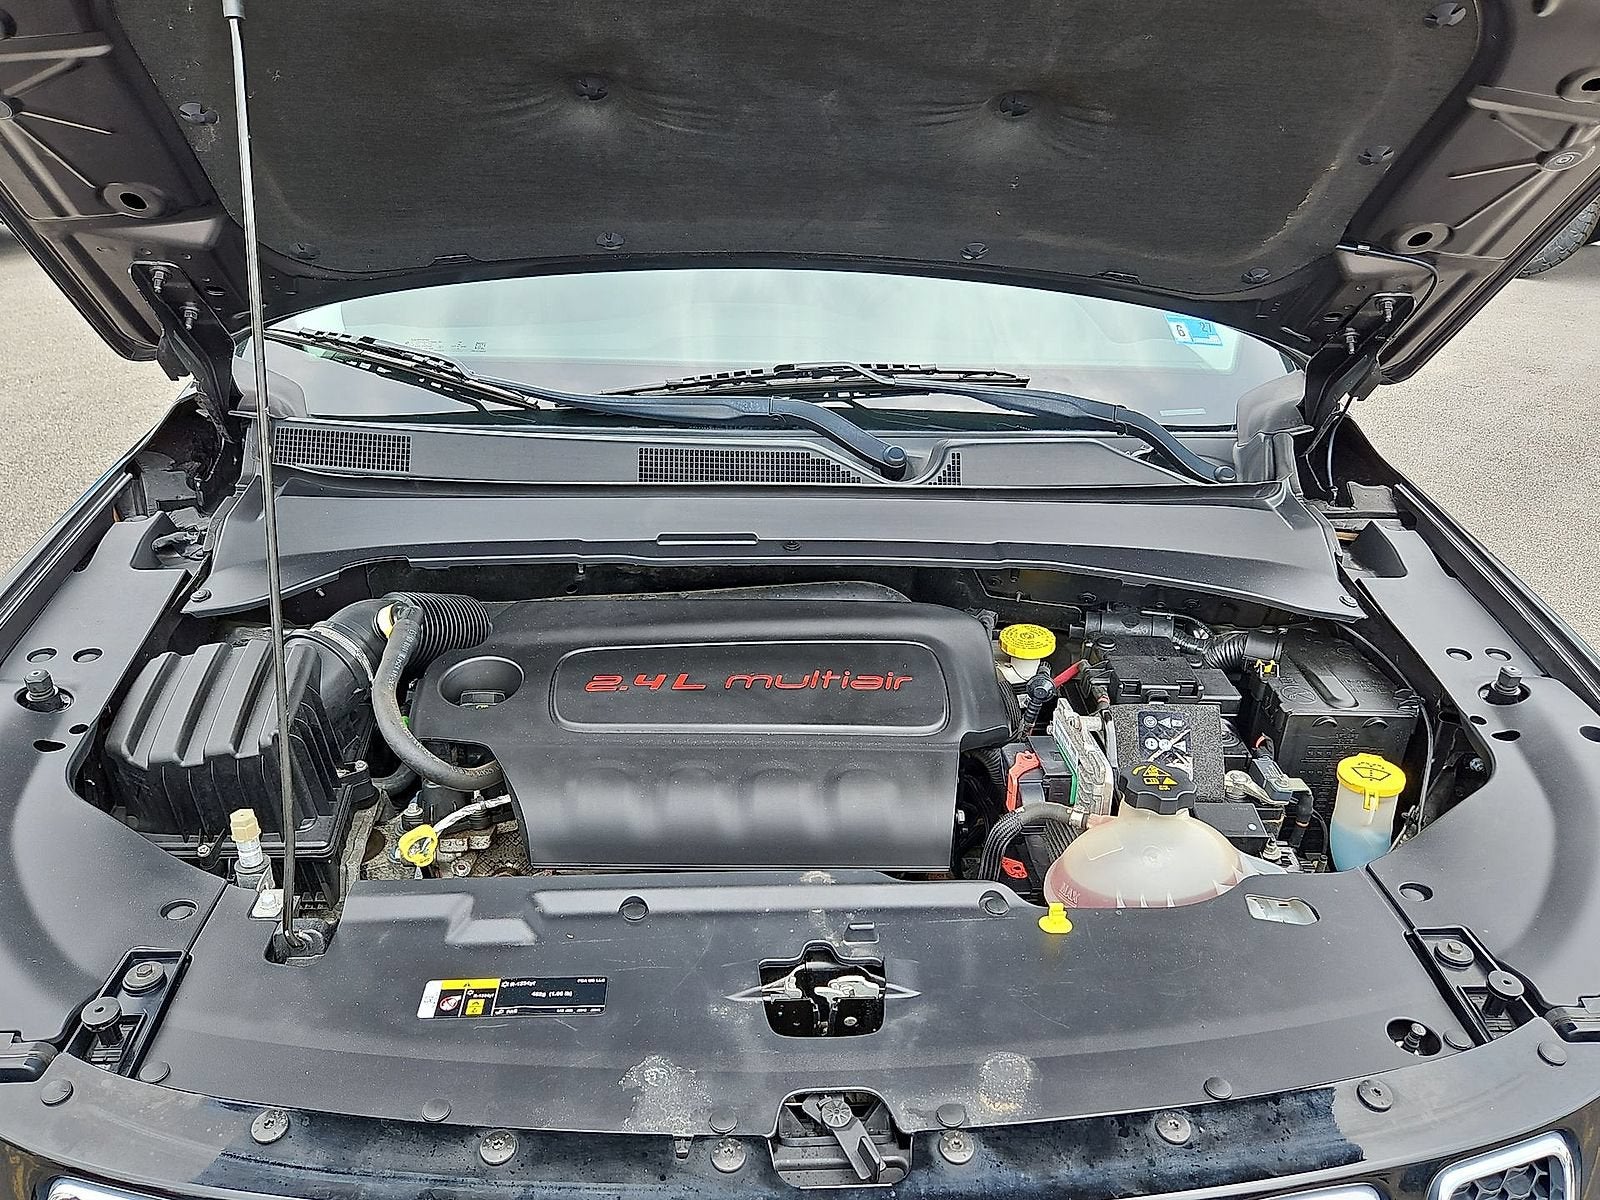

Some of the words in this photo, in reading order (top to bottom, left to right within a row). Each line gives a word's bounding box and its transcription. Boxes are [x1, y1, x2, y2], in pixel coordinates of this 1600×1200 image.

[1176, 324, 1186, 337] 6
[1200, 321, 1213, 333] 27
[724, 669, 914, 690] multiair
